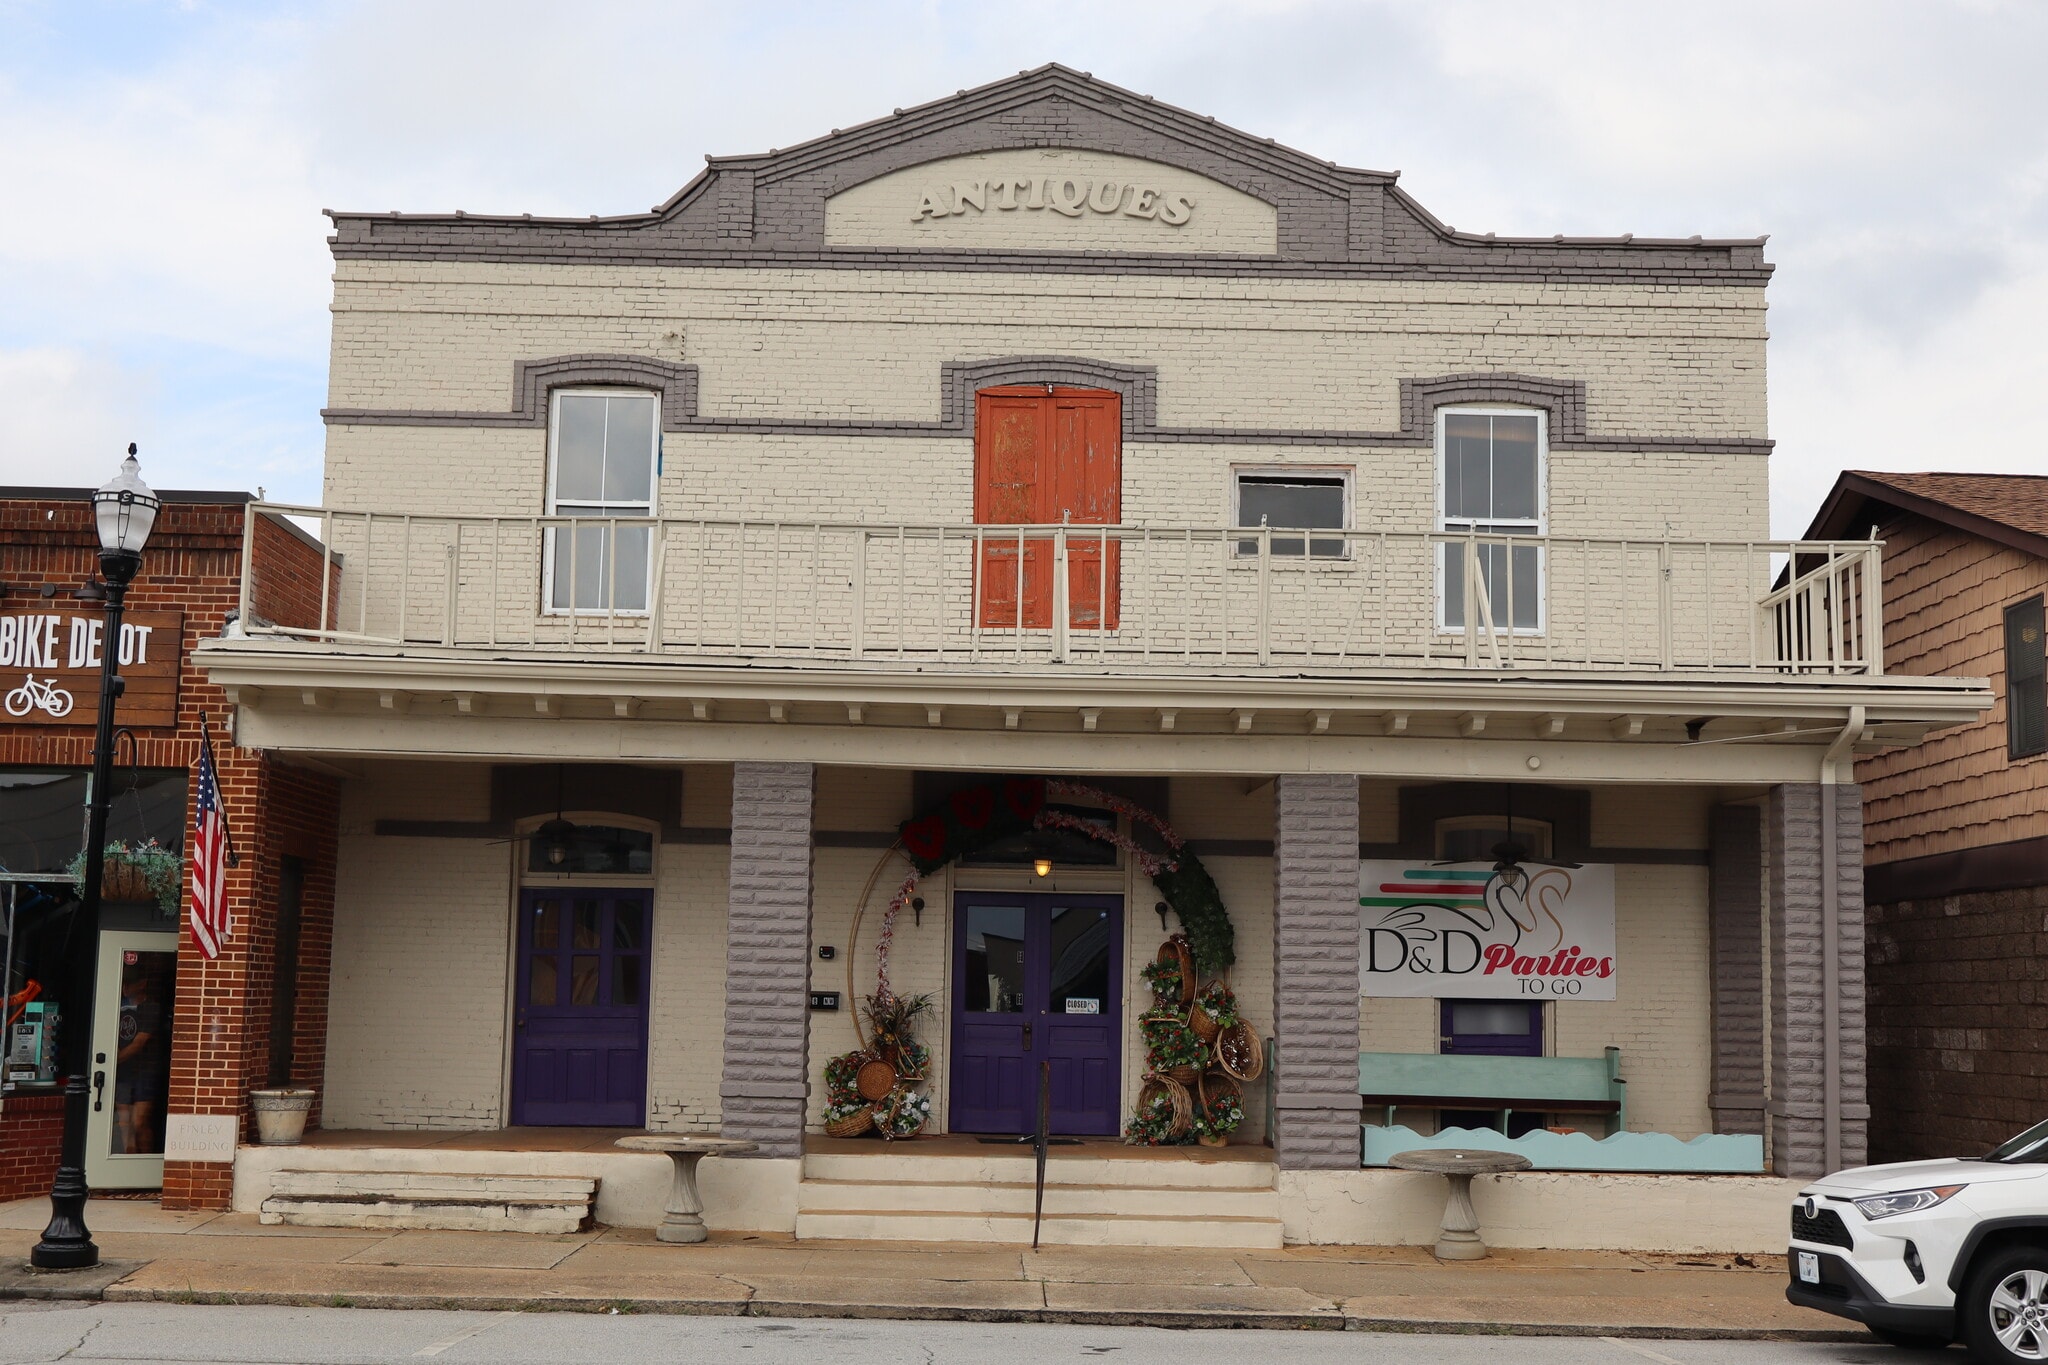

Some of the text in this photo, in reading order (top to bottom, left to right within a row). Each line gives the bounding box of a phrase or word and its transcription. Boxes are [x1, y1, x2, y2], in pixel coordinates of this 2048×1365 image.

[910, 178, 1197, 226] ANTIQUES
[0, 615, 152, 668] BIKE DEOT
[1365, 928, 1615, 979] D&D Parties
[1517, 978, 1582, 995] TO GO
[1067, 999, 1088, 1009] CLOSED
[180, 1125, 221, 1134] FINLEY
[170, 1141, 229, 1151] BUILDING
